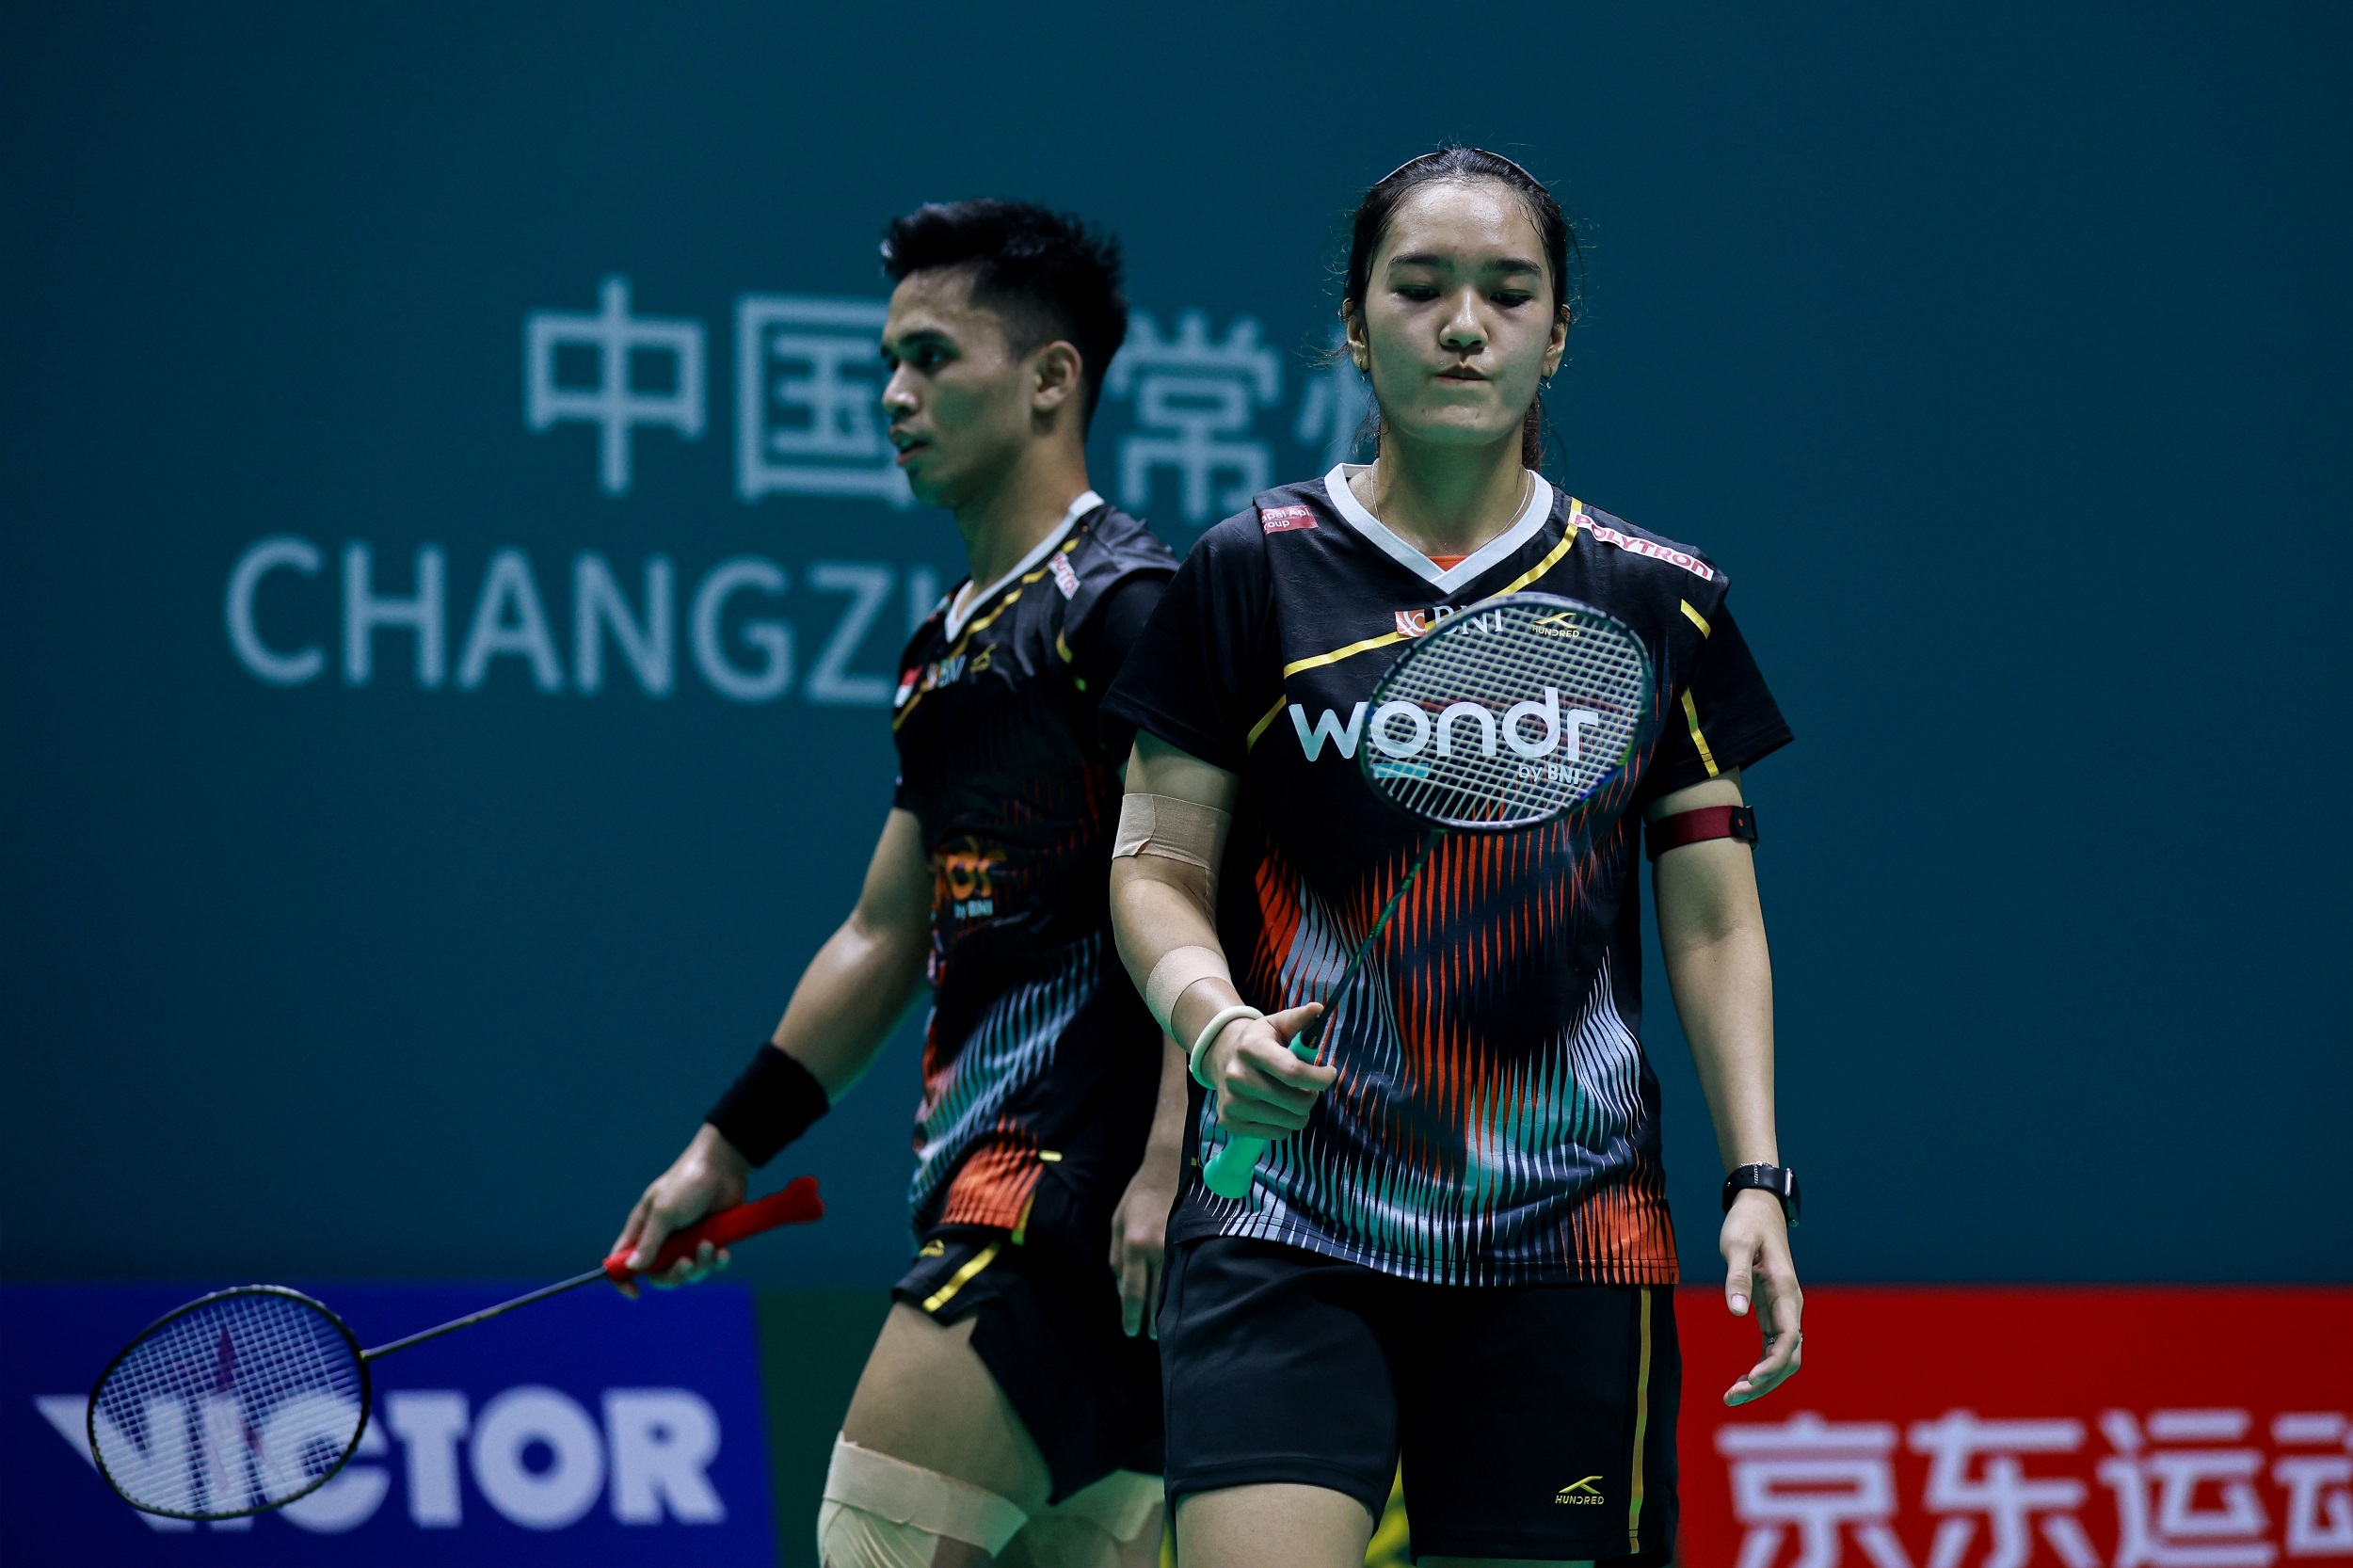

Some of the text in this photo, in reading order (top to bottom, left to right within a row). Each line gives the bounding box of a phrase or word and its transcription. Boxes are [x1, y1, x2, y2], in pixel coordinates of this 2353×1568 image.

[1261, 507, 1310, 523] apal Api
[1263, 520, 1290, 531] roup
[1574, 514, 1709, 578] POLYTRON
[224, 535, 941, 706] CHANGZ
[1432, 604, 1504, 635] BNI
[1531, 624, 1580, 638] HUNDRED
[1289, 686, 1599, 762] wondr
[1518, 762, 1580, 785] by BNI
[33, 1385, 726, 1533] VICTOR
[1555, 1495, 1605, 1505] HUNDRED
